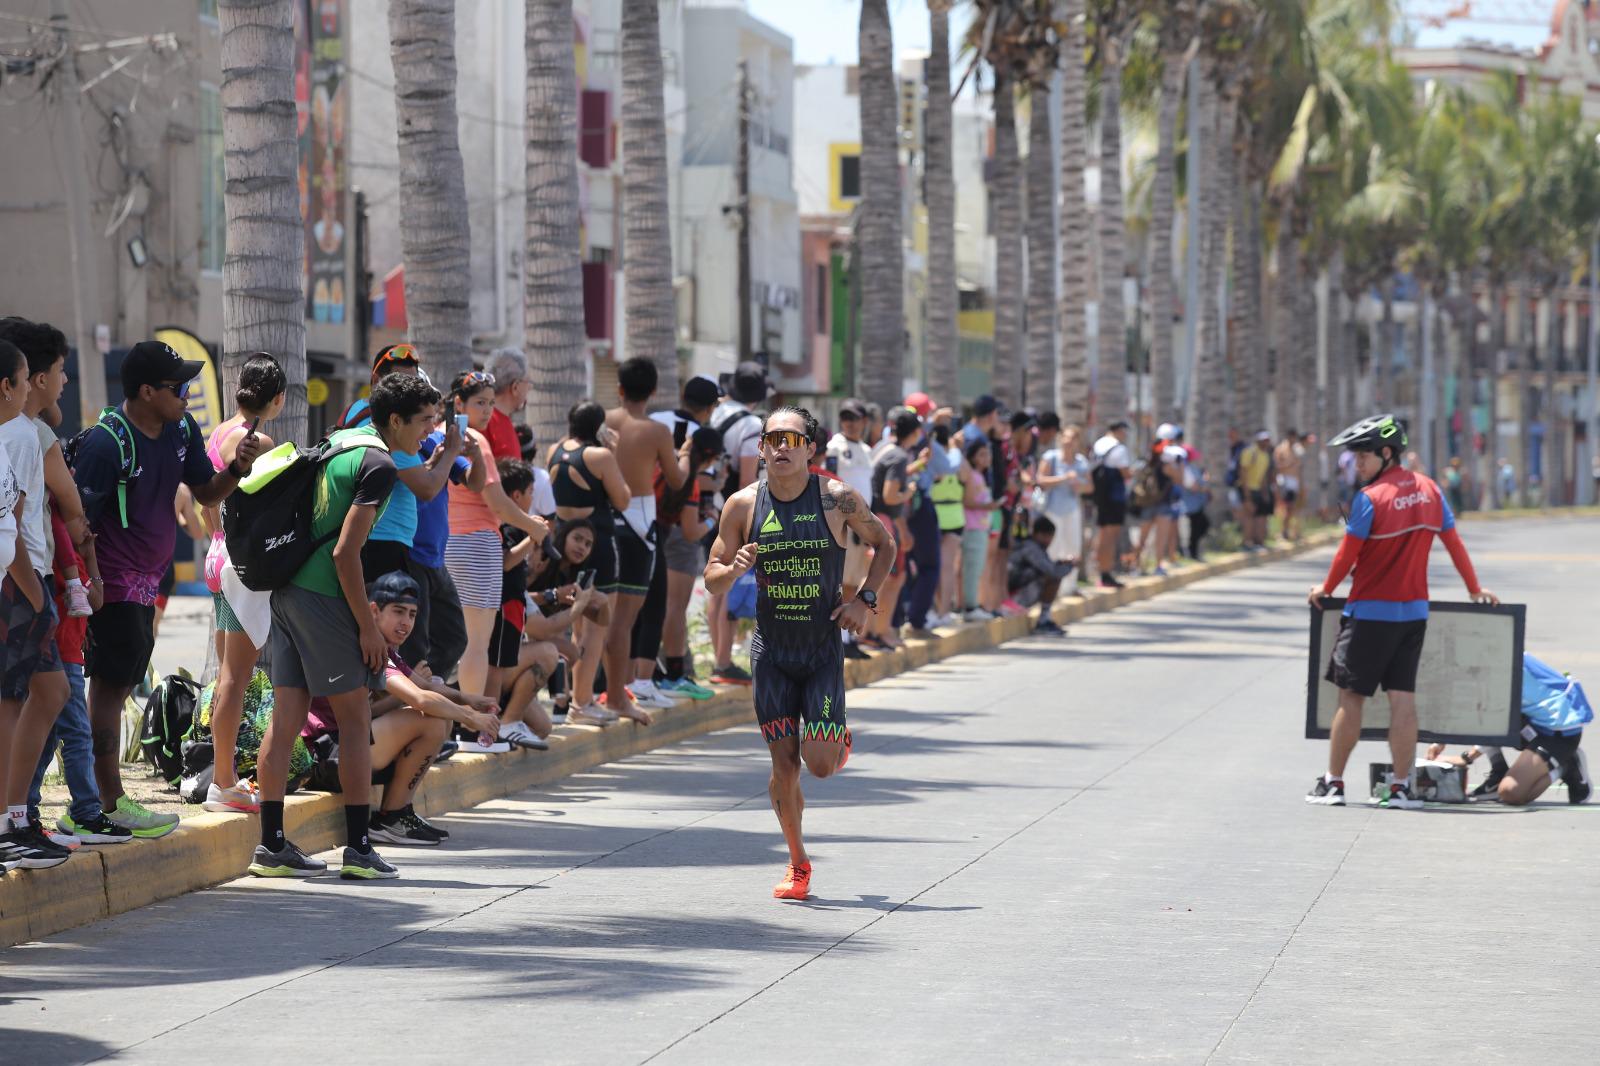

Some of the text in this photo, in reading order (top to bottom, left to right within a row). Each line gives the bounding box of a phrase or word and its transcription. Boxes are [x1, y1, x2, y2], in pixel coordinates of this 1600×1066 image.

[757, 538, 829, 554] SDEPORTE
[763, 556, 820, 575] gaudium
[767, 582, 820, 599] PEÑAFLOR
